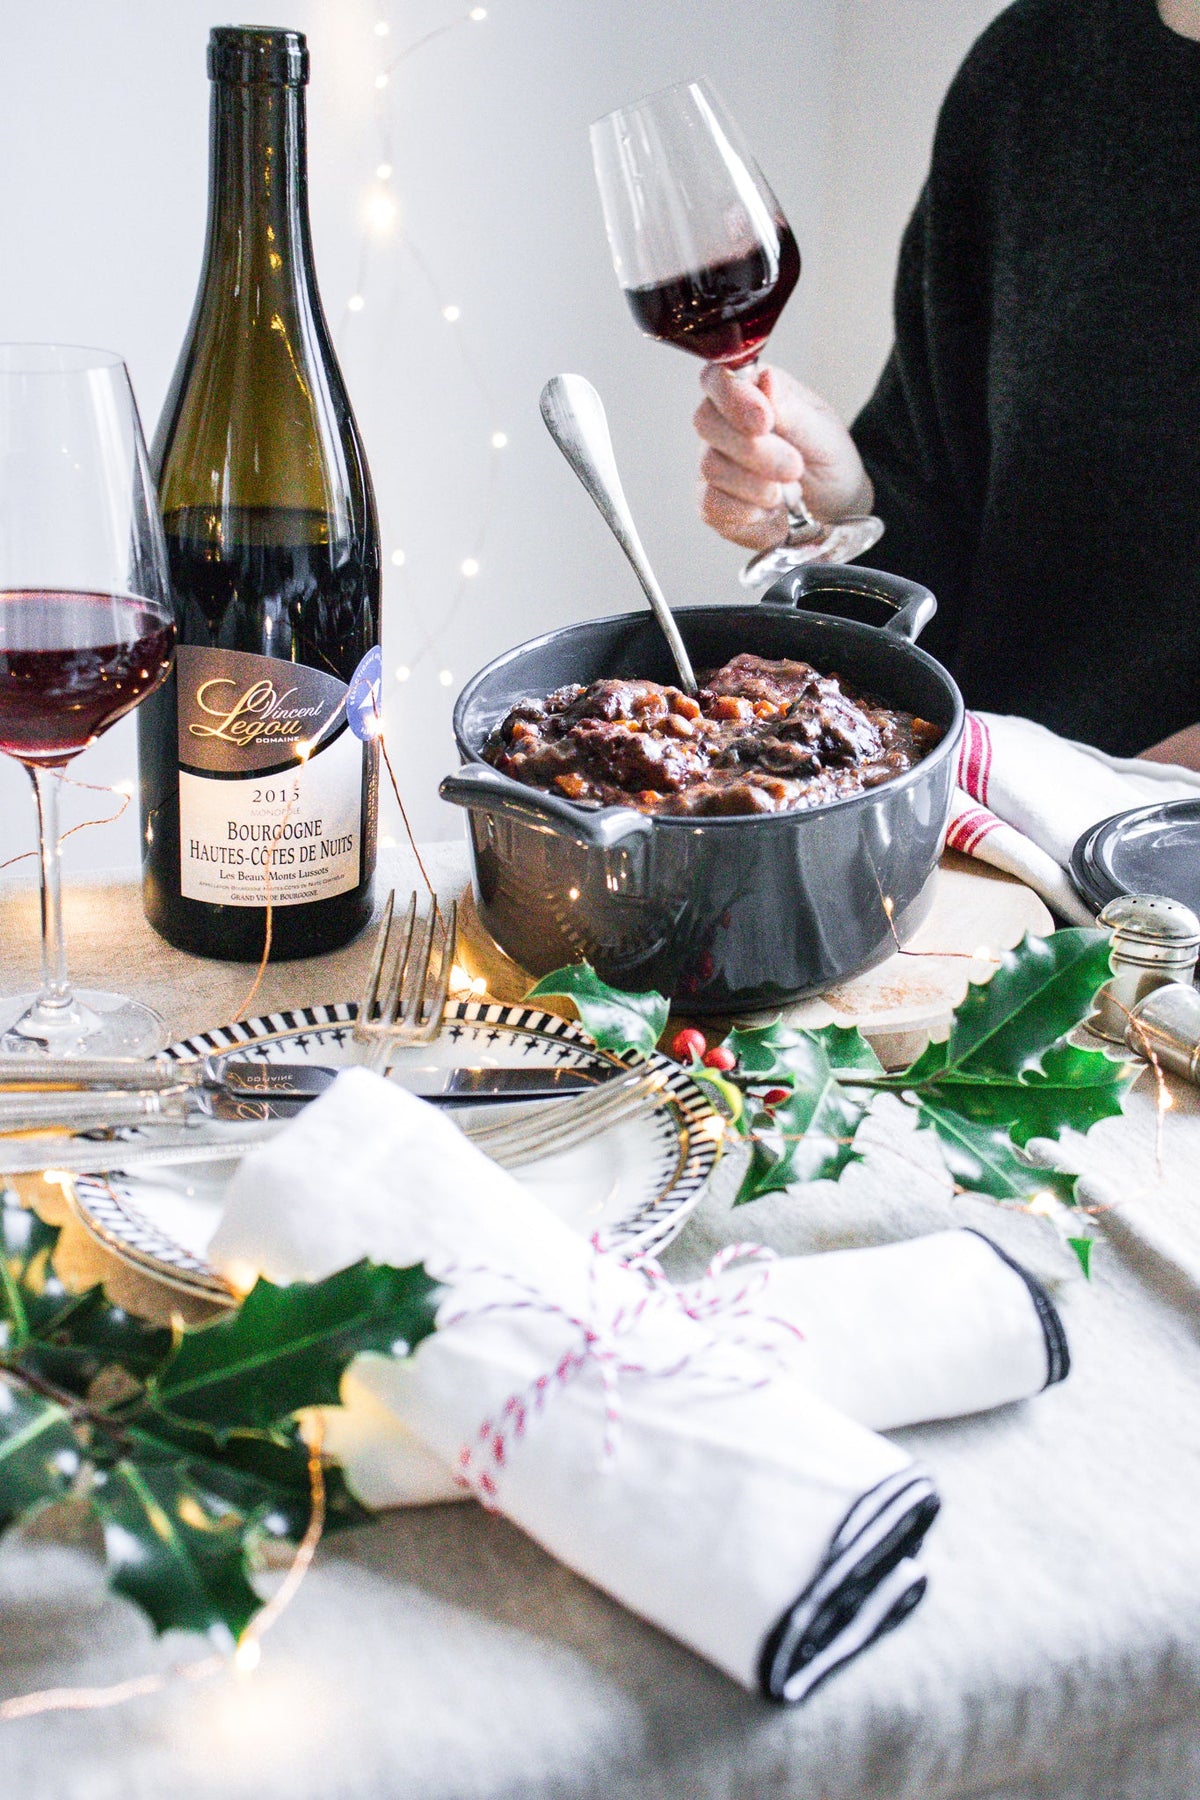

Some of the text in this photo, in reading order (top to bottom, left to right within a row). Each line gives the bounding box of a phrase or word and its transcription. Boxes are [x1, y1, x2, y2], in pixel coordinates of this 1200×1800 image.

[189, 678, 302, 747] Legou
[247, 687, 325, 720] Vincent
[255, 736, 300, 744] DOMAINE
[252, 788, 300, 803] 2015
[227, 819, 323, 841] BOURGOGNE
[190, 834, 353, 865] HAUTES-CÔTES DE NUITS
[219, 867, 329, 881] Les Beaux Monts Lussots
[230, 893, 255, 901] GRAND
[279, 889, 318, 901] BOURGOGNE
